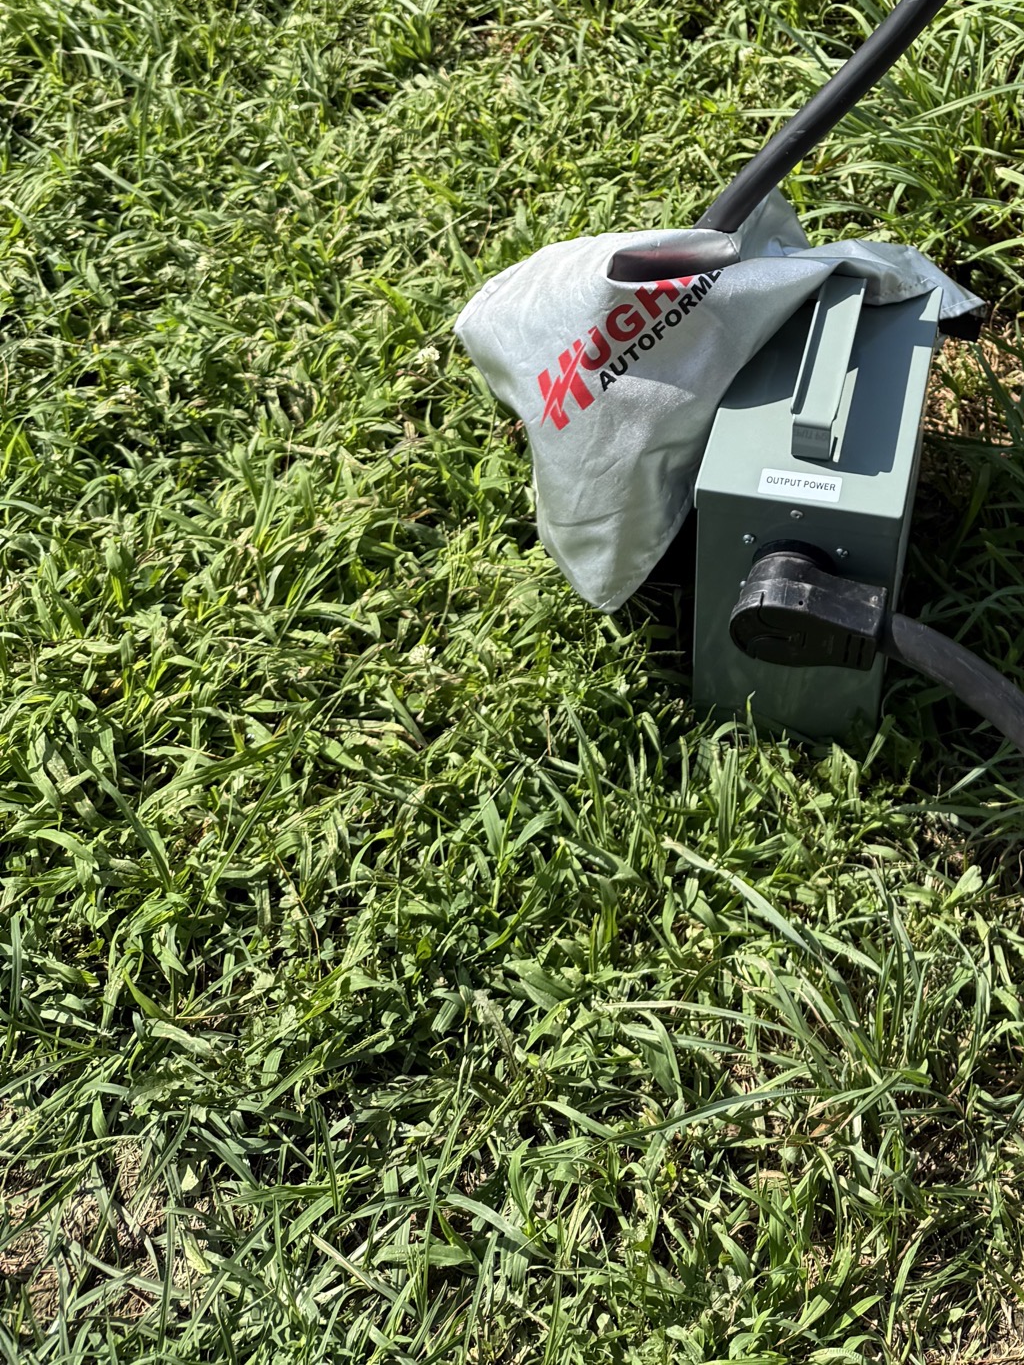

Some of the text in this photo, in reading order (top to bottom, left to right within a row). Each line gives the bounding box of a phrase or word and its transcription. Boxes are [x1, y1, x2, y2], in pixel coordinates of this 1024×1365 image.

[537, 276, 695, 431] HUGH
[599, 268, 724, 392] AUTOFORME
[766, 476, 836, 492] OUTPUT POWER
